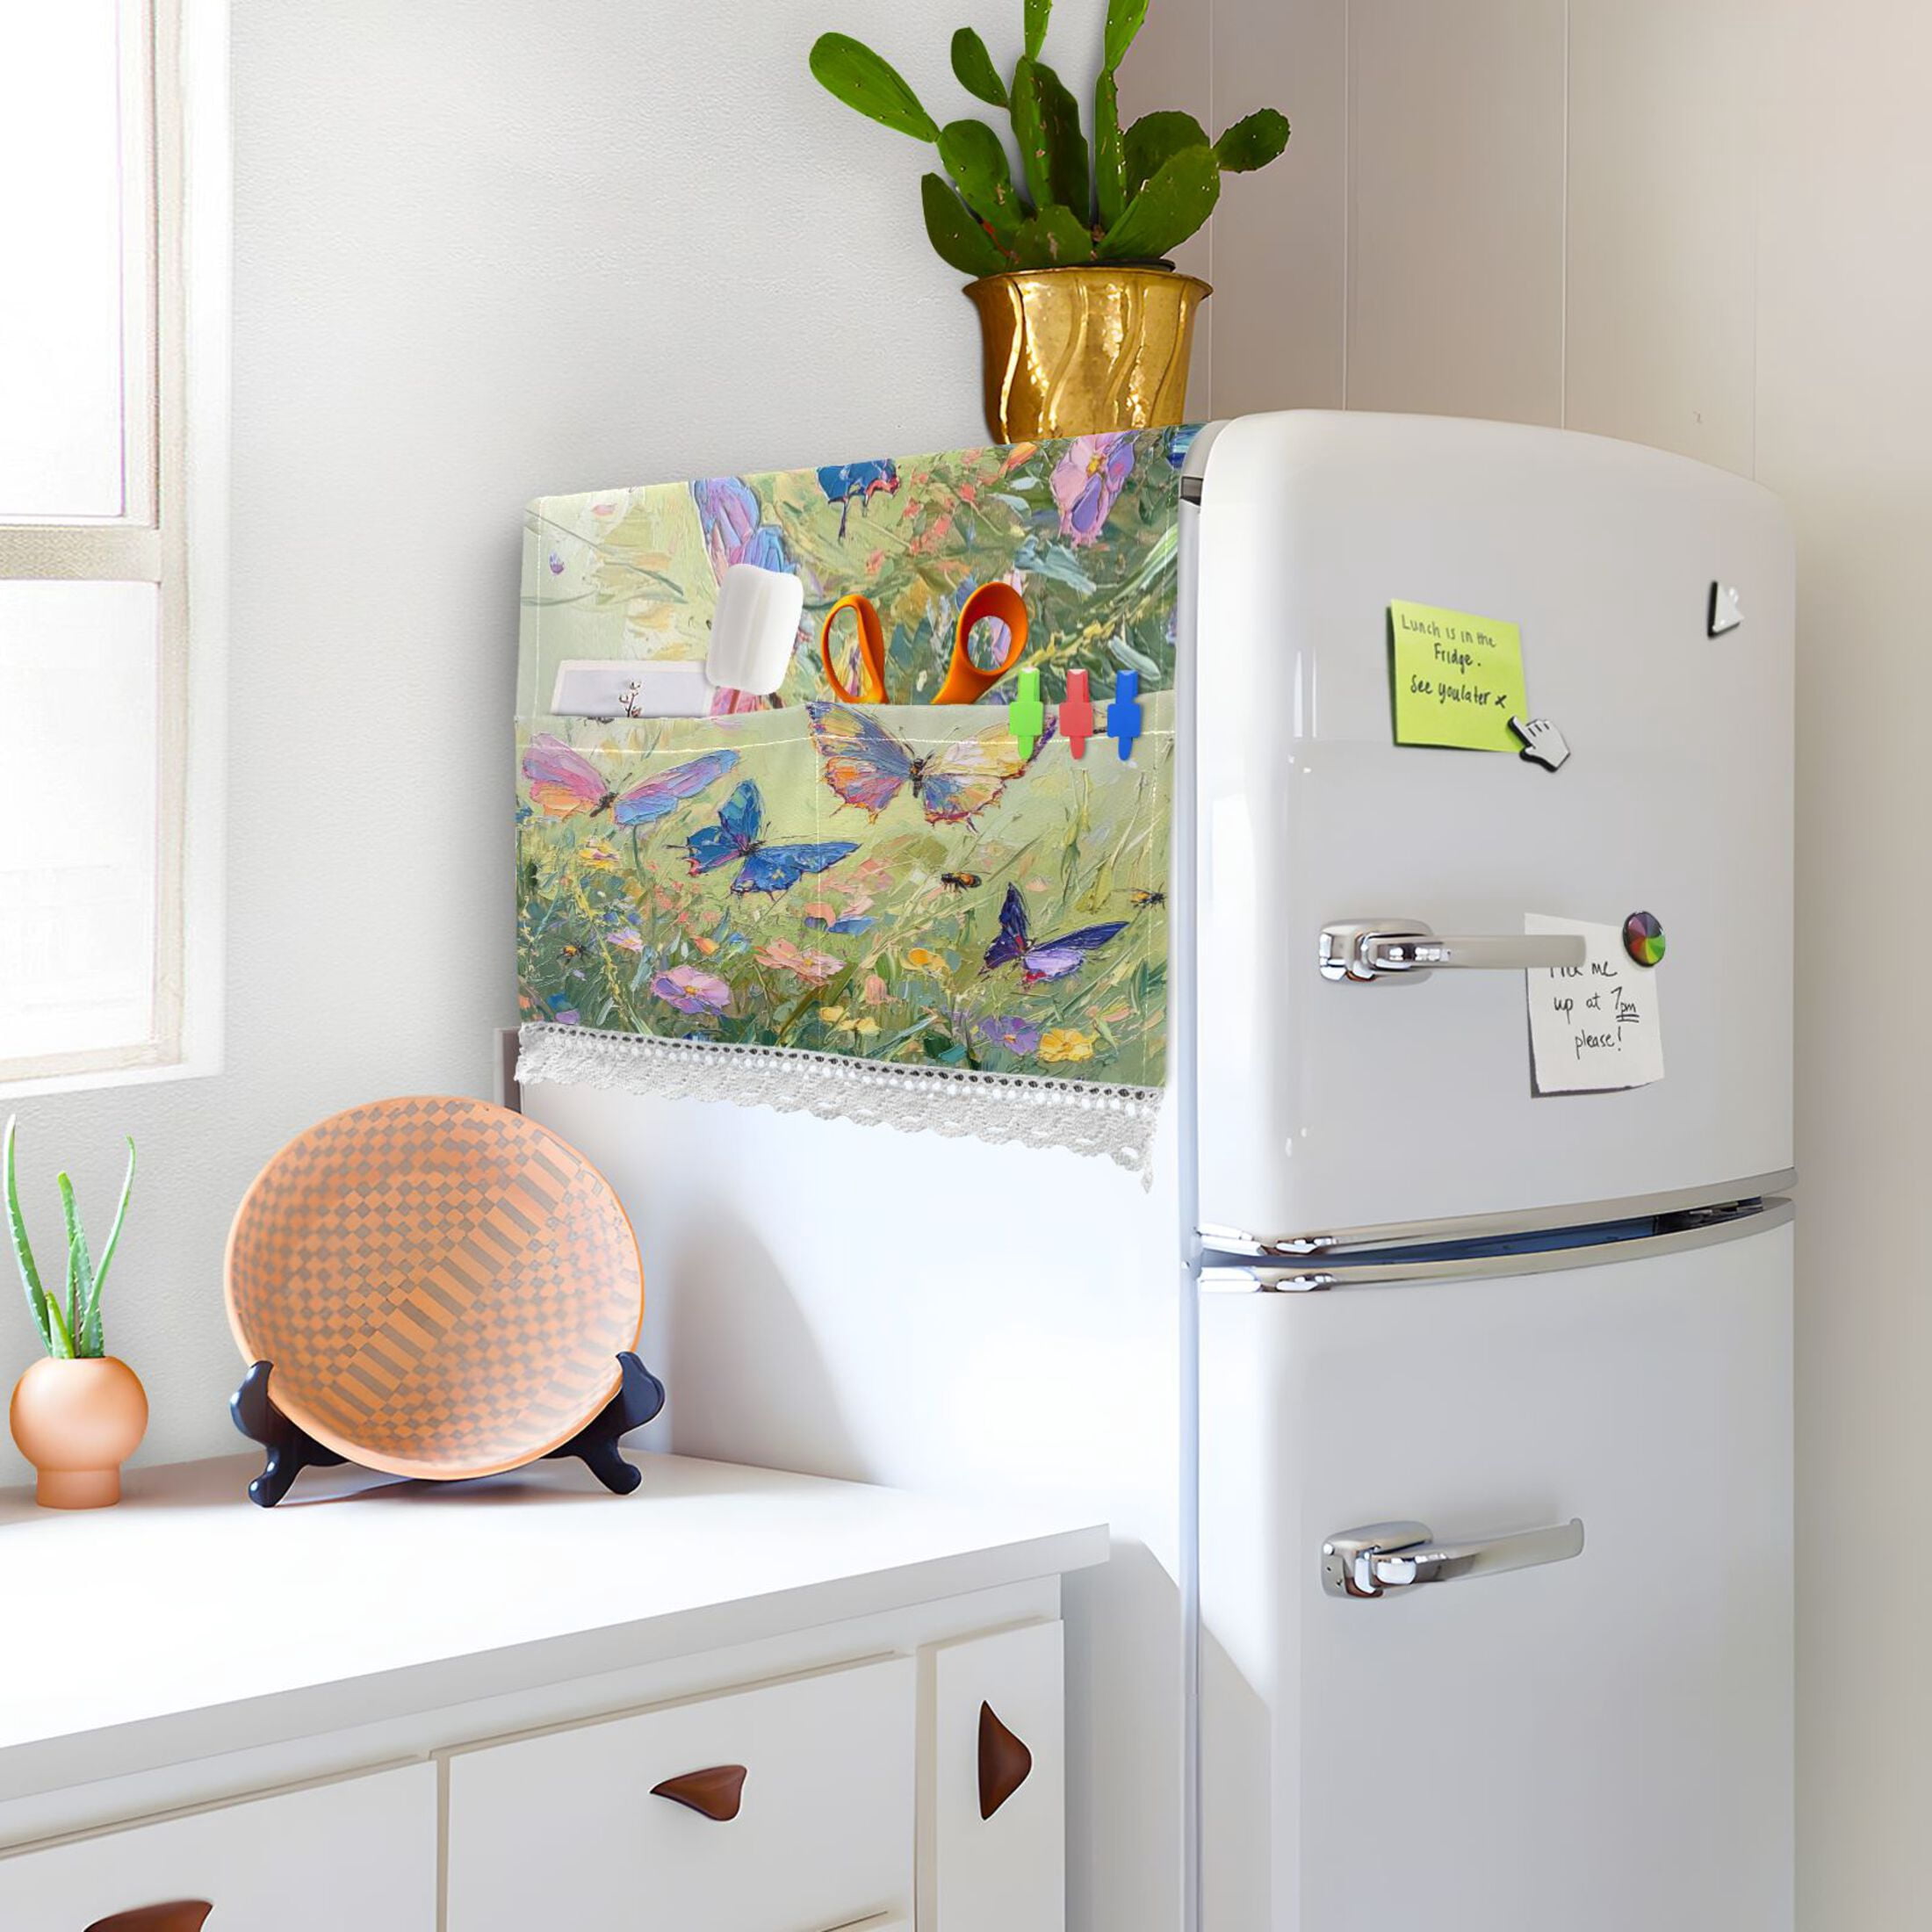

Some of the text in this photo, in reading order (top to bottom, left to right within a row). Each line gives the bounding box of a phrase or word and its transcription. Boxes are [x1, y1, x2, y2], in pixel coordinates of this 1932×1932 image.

[1401, 613, 1497, 648] Lunch is in the
[1410, 674, 1433, 694] See
[1554, 996, 1574, 1025] up
[1586, 991, 1602, 1011] at
[1575, 1026, 1622, 1060] please!
